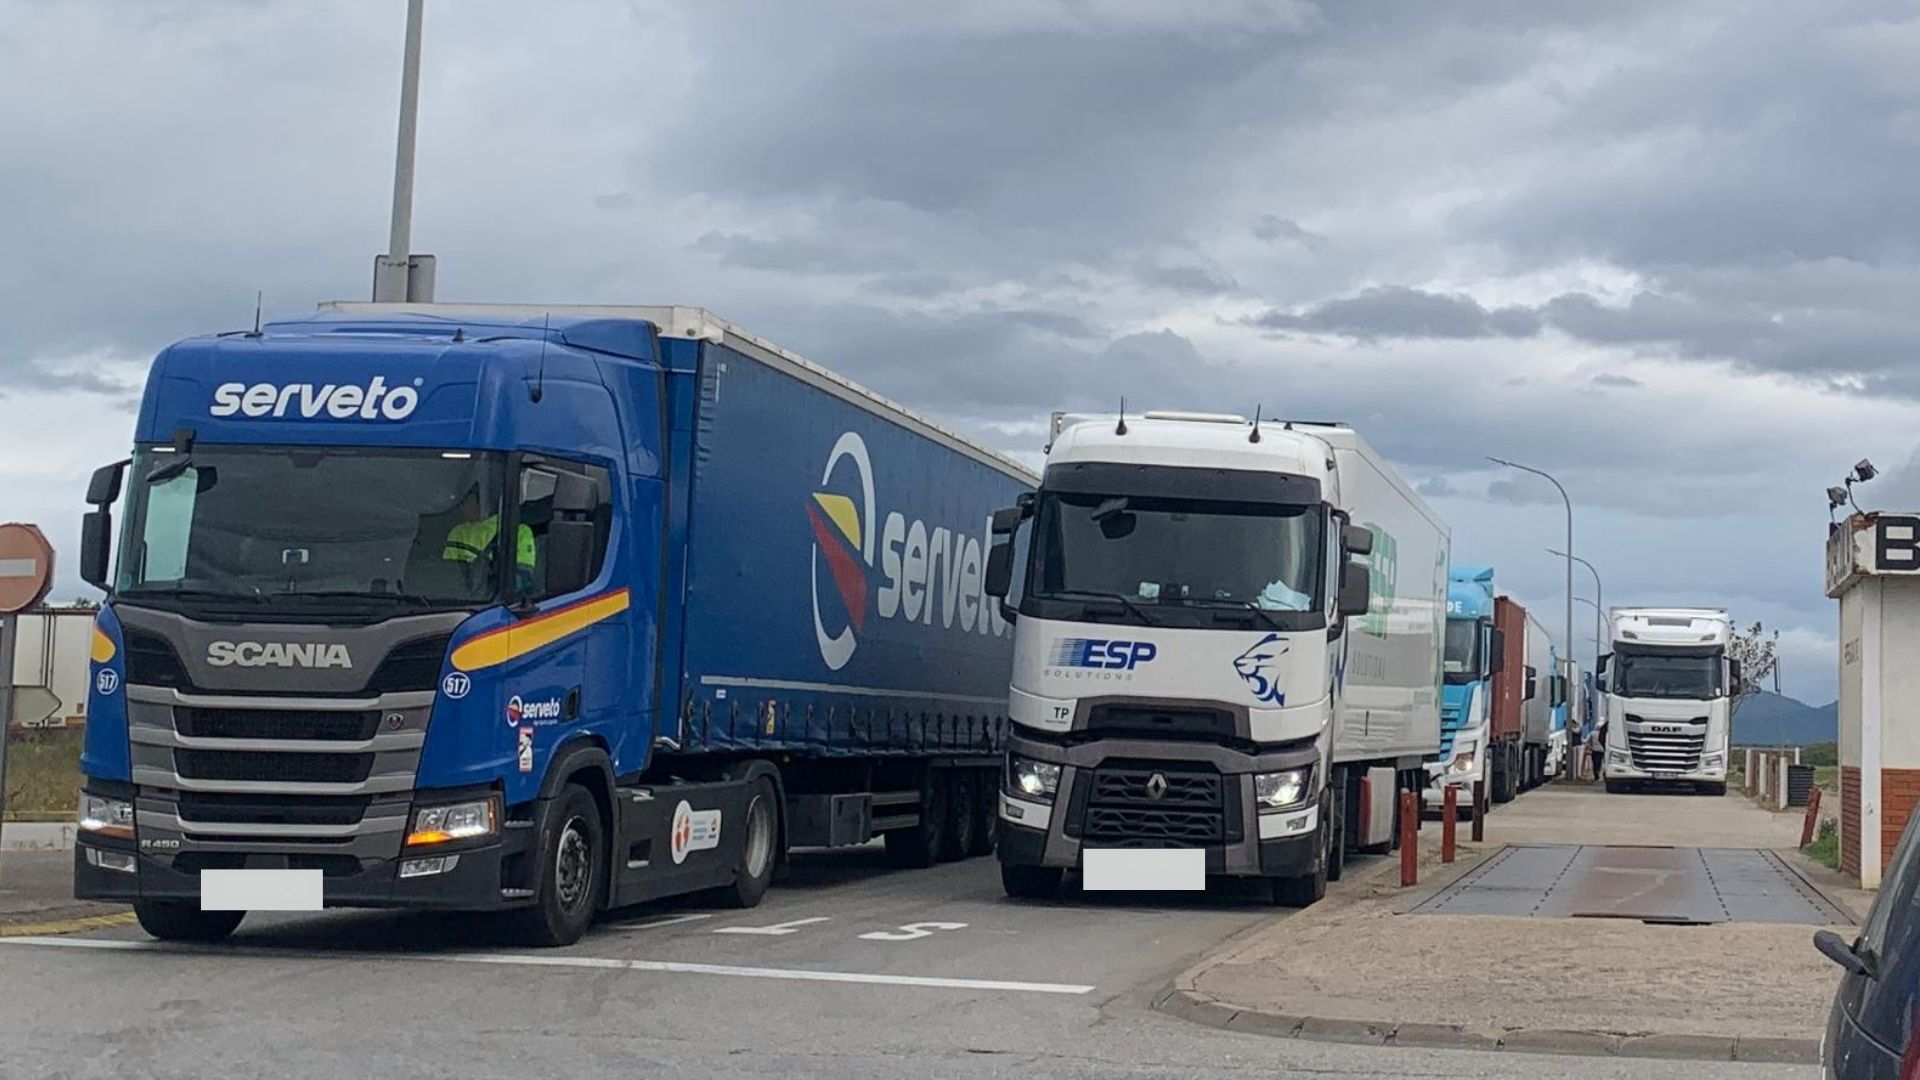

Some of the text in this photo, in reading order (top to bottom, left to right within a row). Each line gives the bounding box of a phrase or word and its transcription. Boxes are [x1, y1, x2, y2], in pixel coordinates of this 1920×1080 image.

[209, 375, 418, 420] serveto
[206, 640, 353, 669] SCANIA
[1072, 637, 1157, 671] ESP
[99, 674, 116, 690] 517
[1044, 669, 1133, 681] SOLUTIONS
[446, 677, 467, 695] 517
[522, 697, 560, 719] serveto
[1054, 707, 1070, 719] TP
[1651, 725, 1682, 733] DAF
